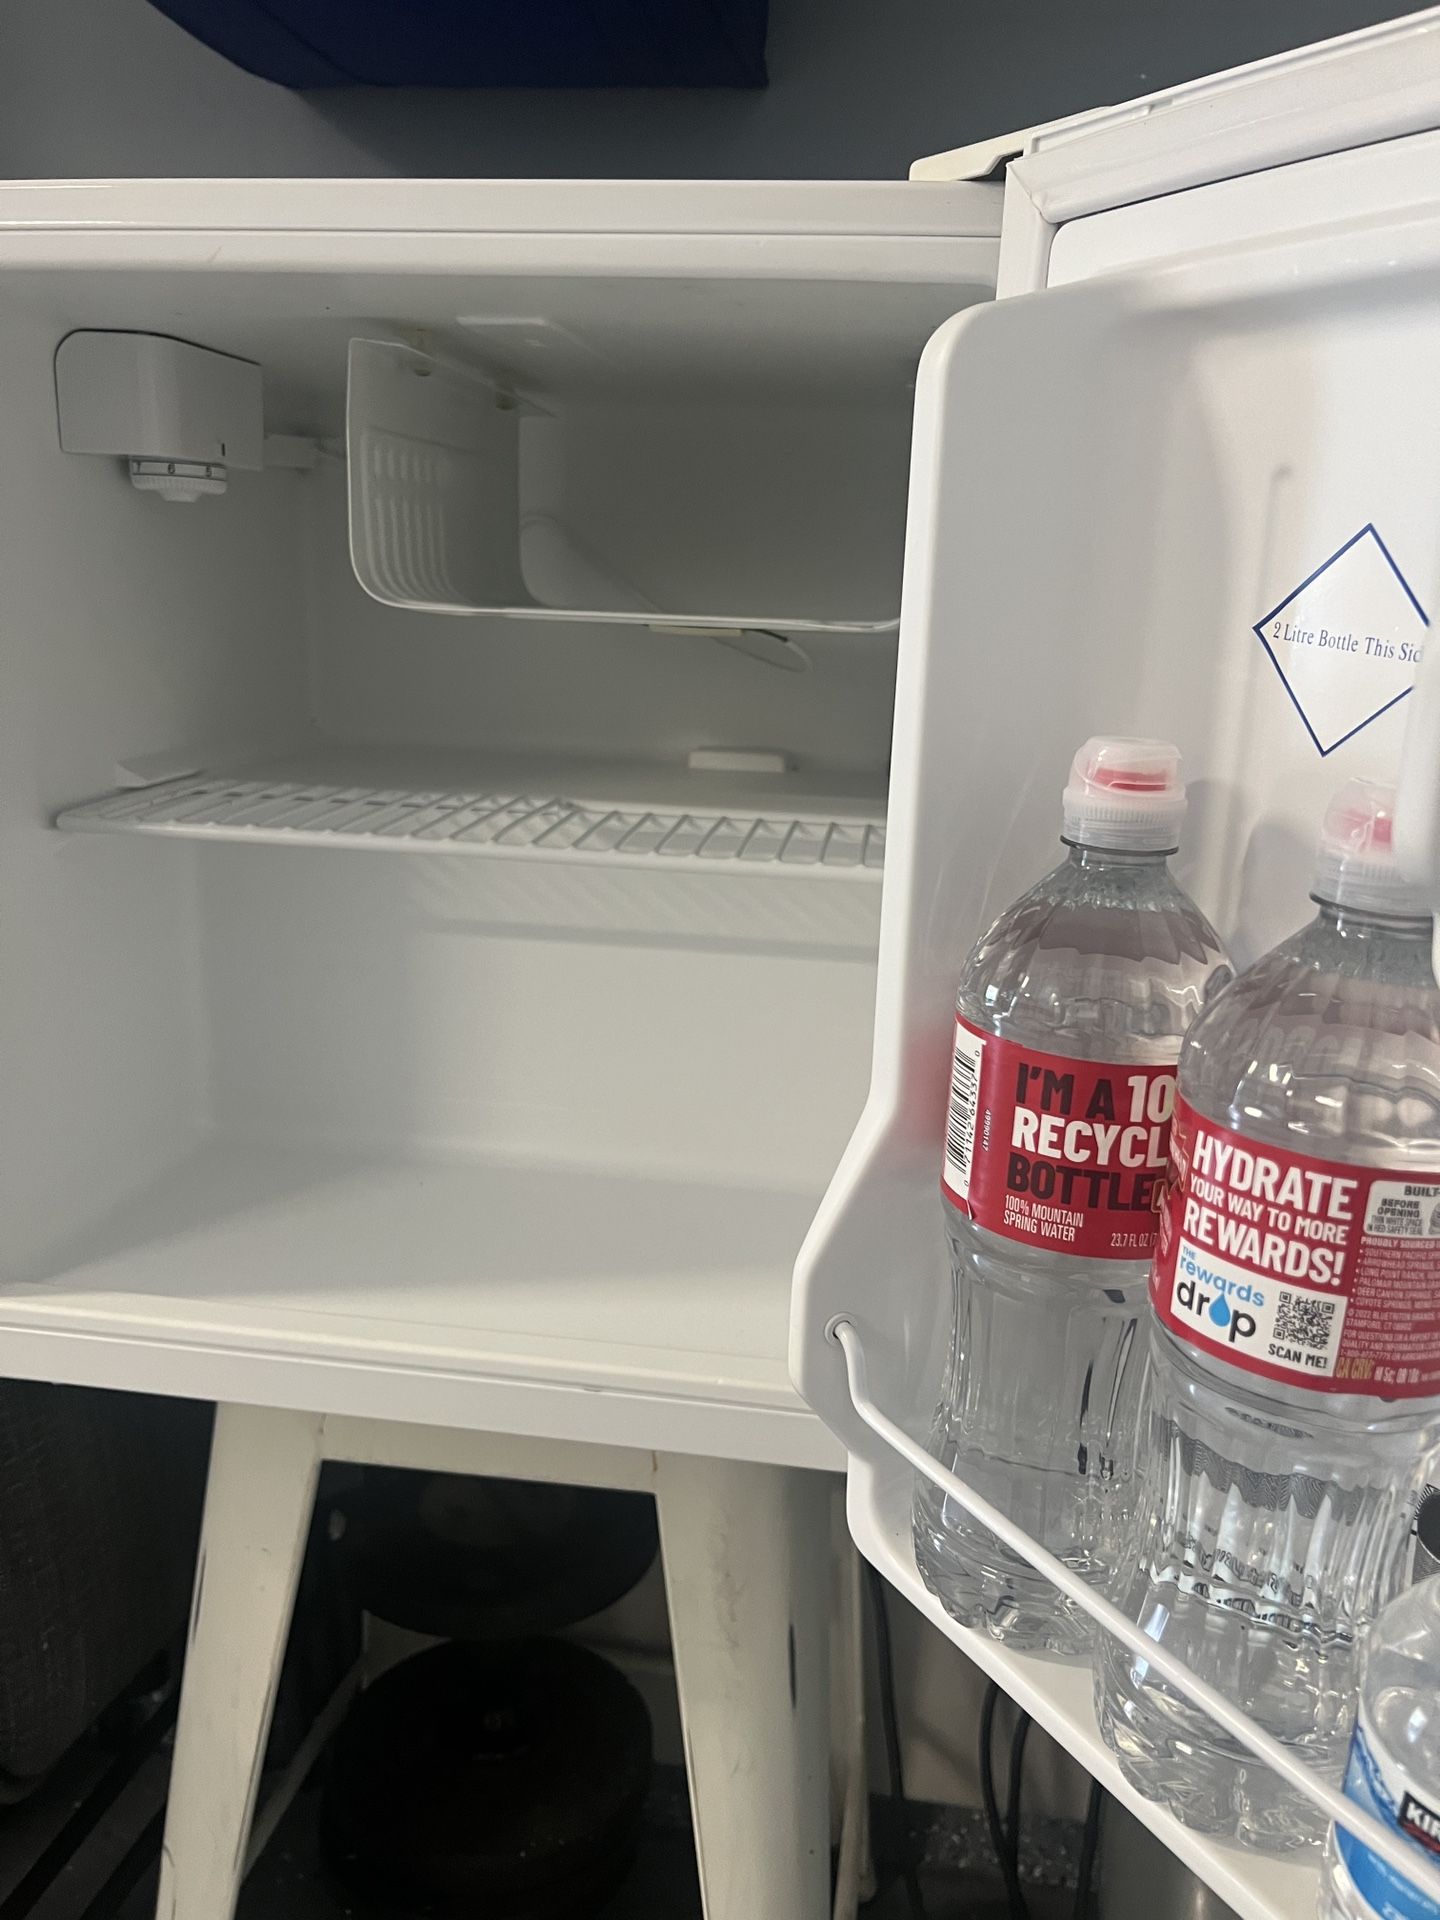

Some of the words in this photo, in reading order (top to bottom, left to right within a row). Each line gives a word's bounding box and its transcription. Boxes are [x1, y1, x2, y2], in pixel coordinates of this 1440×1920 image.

[1273, 621, 1281, 639] 2
[1284, 623, 1314, 645] Litre
[1318, 629, 1359, 653] Bottle
[1365, 636, 1395, 659] This
[1015, 1062, 1075, 1116] I'M
[1085, 1078, 1116, 1121] A
[1127, 1074, 1177, 1124] 10
[982, 1108, 992, 1152] 49990147
[1011, 1105, 1169, 1168] RECYCL
[1007, 1152, 1157, 1212] BOTTLE
[1192, 1129, 1359, 1221] HYDRATE
[1004, 1194, 1030, 1214] 100%
[1031, 1203, 1084, 1228] MOUNTAIN
[1190, 1173, 1225, 1208] YOUR
[1227, 1192, 1265, 1222] WAY
[1267, 1207, 1292, 1232] TO
[1294, 1215, 1349, 1246] MORE
[1377, 1207, 1420, 1218] OPENING
[1381, 1198, 1420, 1209] BEFORE
[1003, 1210, 1037, 1234] SPRING
[1040, 1222, 1076, 1242] WATER
[1110, 1232, 1128, 1247] 23.7
[1129, 1233, 1138, 1248] FL
[1138, 1233, 1148, 1247] OZ
[1183, 1197, 1345, 1286] REWARDS!
[1360, 1236, 1399, 1248] PROUDLY
[1400, 1239, 1436, 1249] SOURCED
[1183, 1245, 1197, 1261] THE
[1180, 1255, 1265, 1307] rewards
[1268, 1343, 1302, 1364] SCAN
[1304, 1355, 1328, 1369] ME!
[1406, 1802, 1440, 1842] KIR
